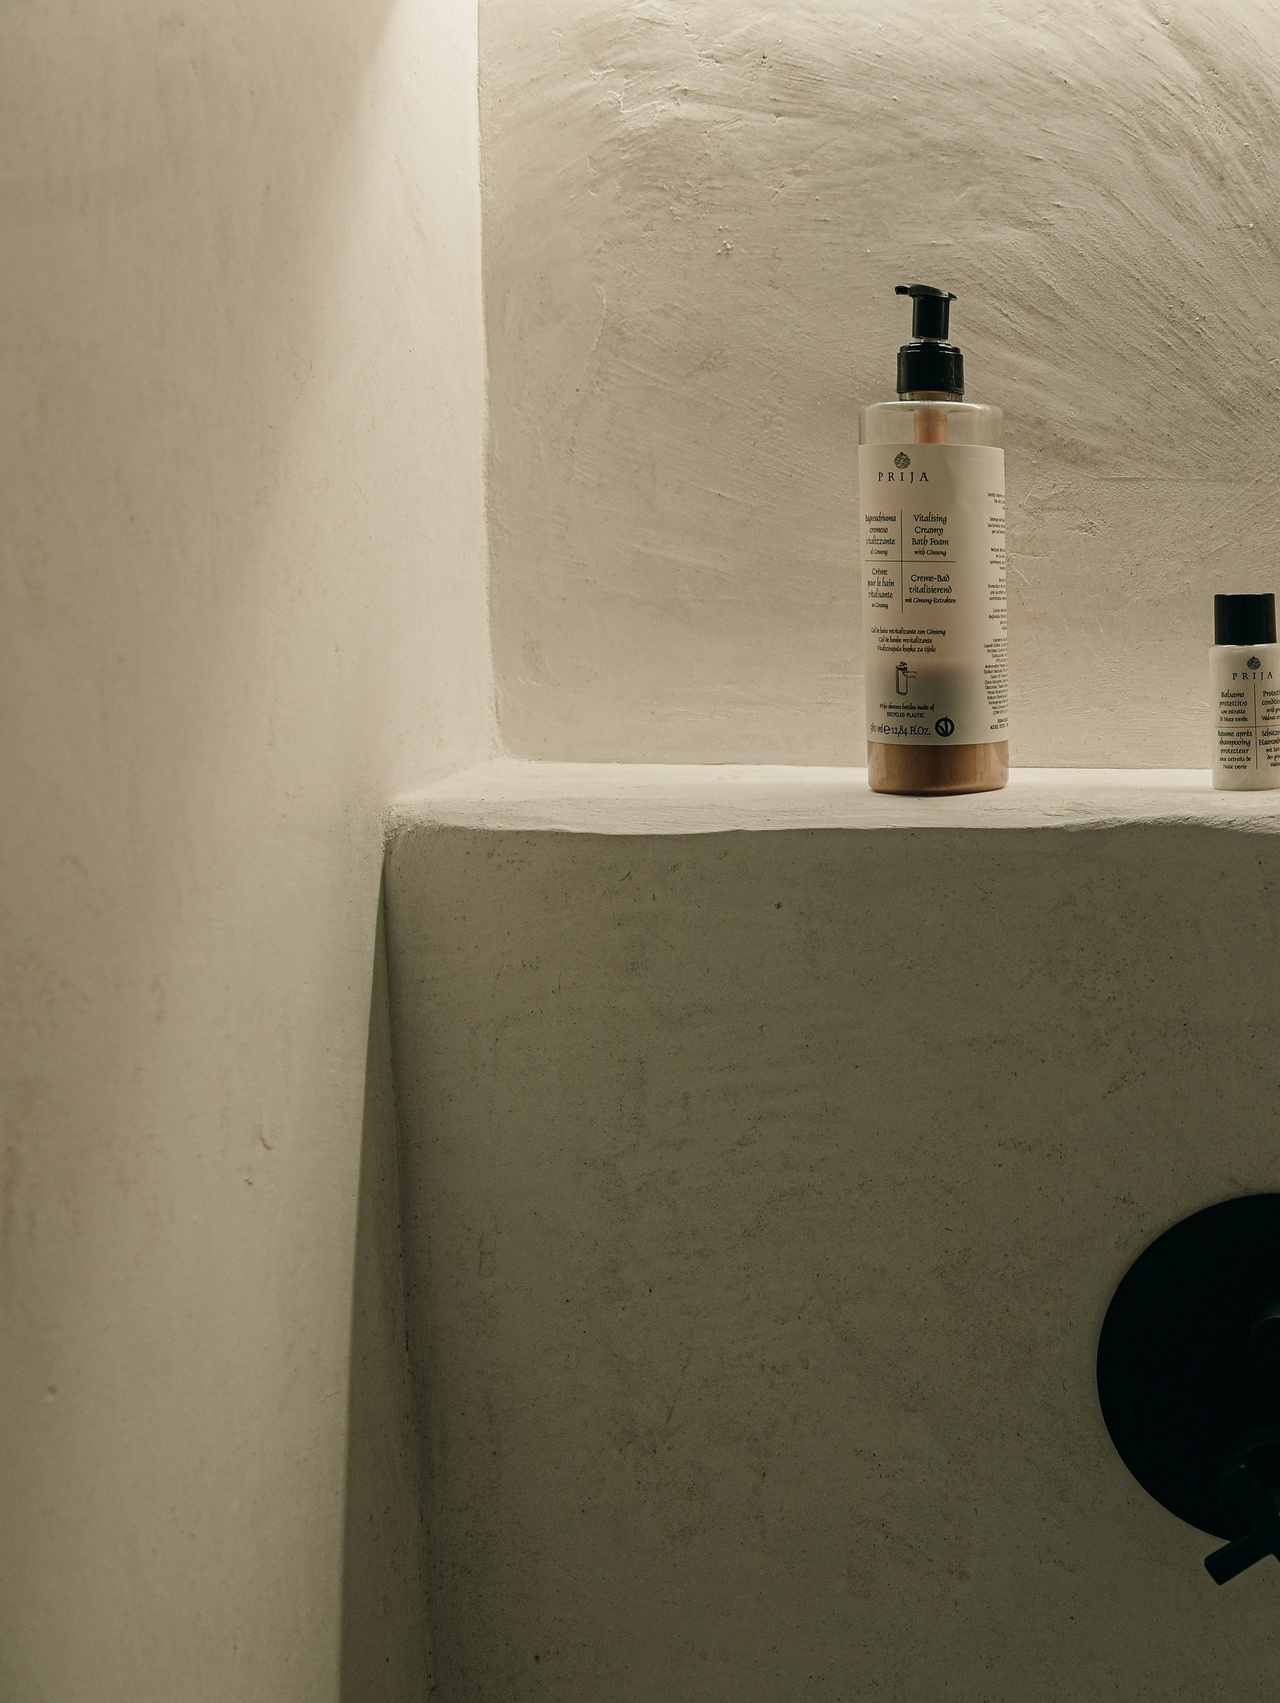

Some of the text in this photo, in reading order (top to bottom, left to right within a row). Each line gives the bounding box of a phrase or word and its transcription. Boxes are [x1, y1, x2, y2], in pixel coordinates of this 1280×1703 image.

[878, 472, 929, 484] PRIJA
[914, 512, 948, 524] Vitalising
[914, 526, 944, 536] Creamy
[912, 535, 928, 546] Bath
[910, 574, 950, 582] Creme-Bad
[909, 583, 952, 594] vitalisierend
[1232, 672, 1273, 681] PRIJA
[1221, 689, 1244, 698] Balsamo
